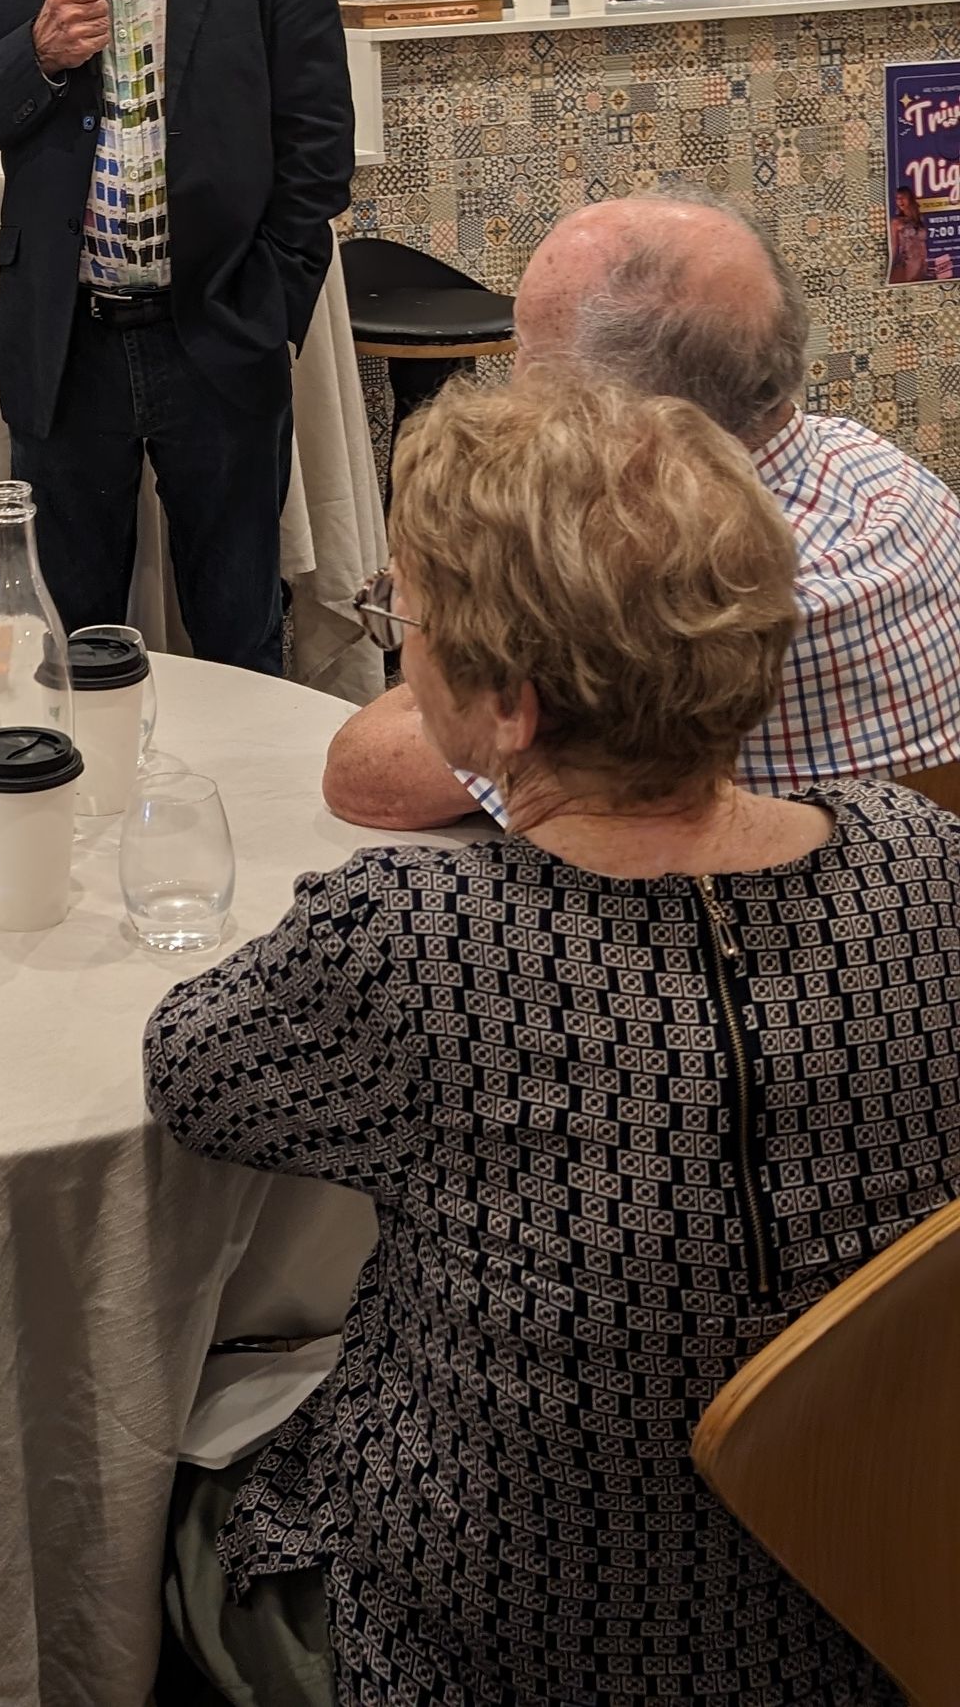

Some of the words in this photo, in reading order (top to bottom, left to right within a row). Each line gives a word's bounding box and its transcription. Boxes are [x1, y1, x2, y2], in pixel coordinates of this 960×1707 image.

[904, 97, 960, 137] Triv
[905, 156, 960, 205] Nig
[928, 225, 954, 238] 7:00
